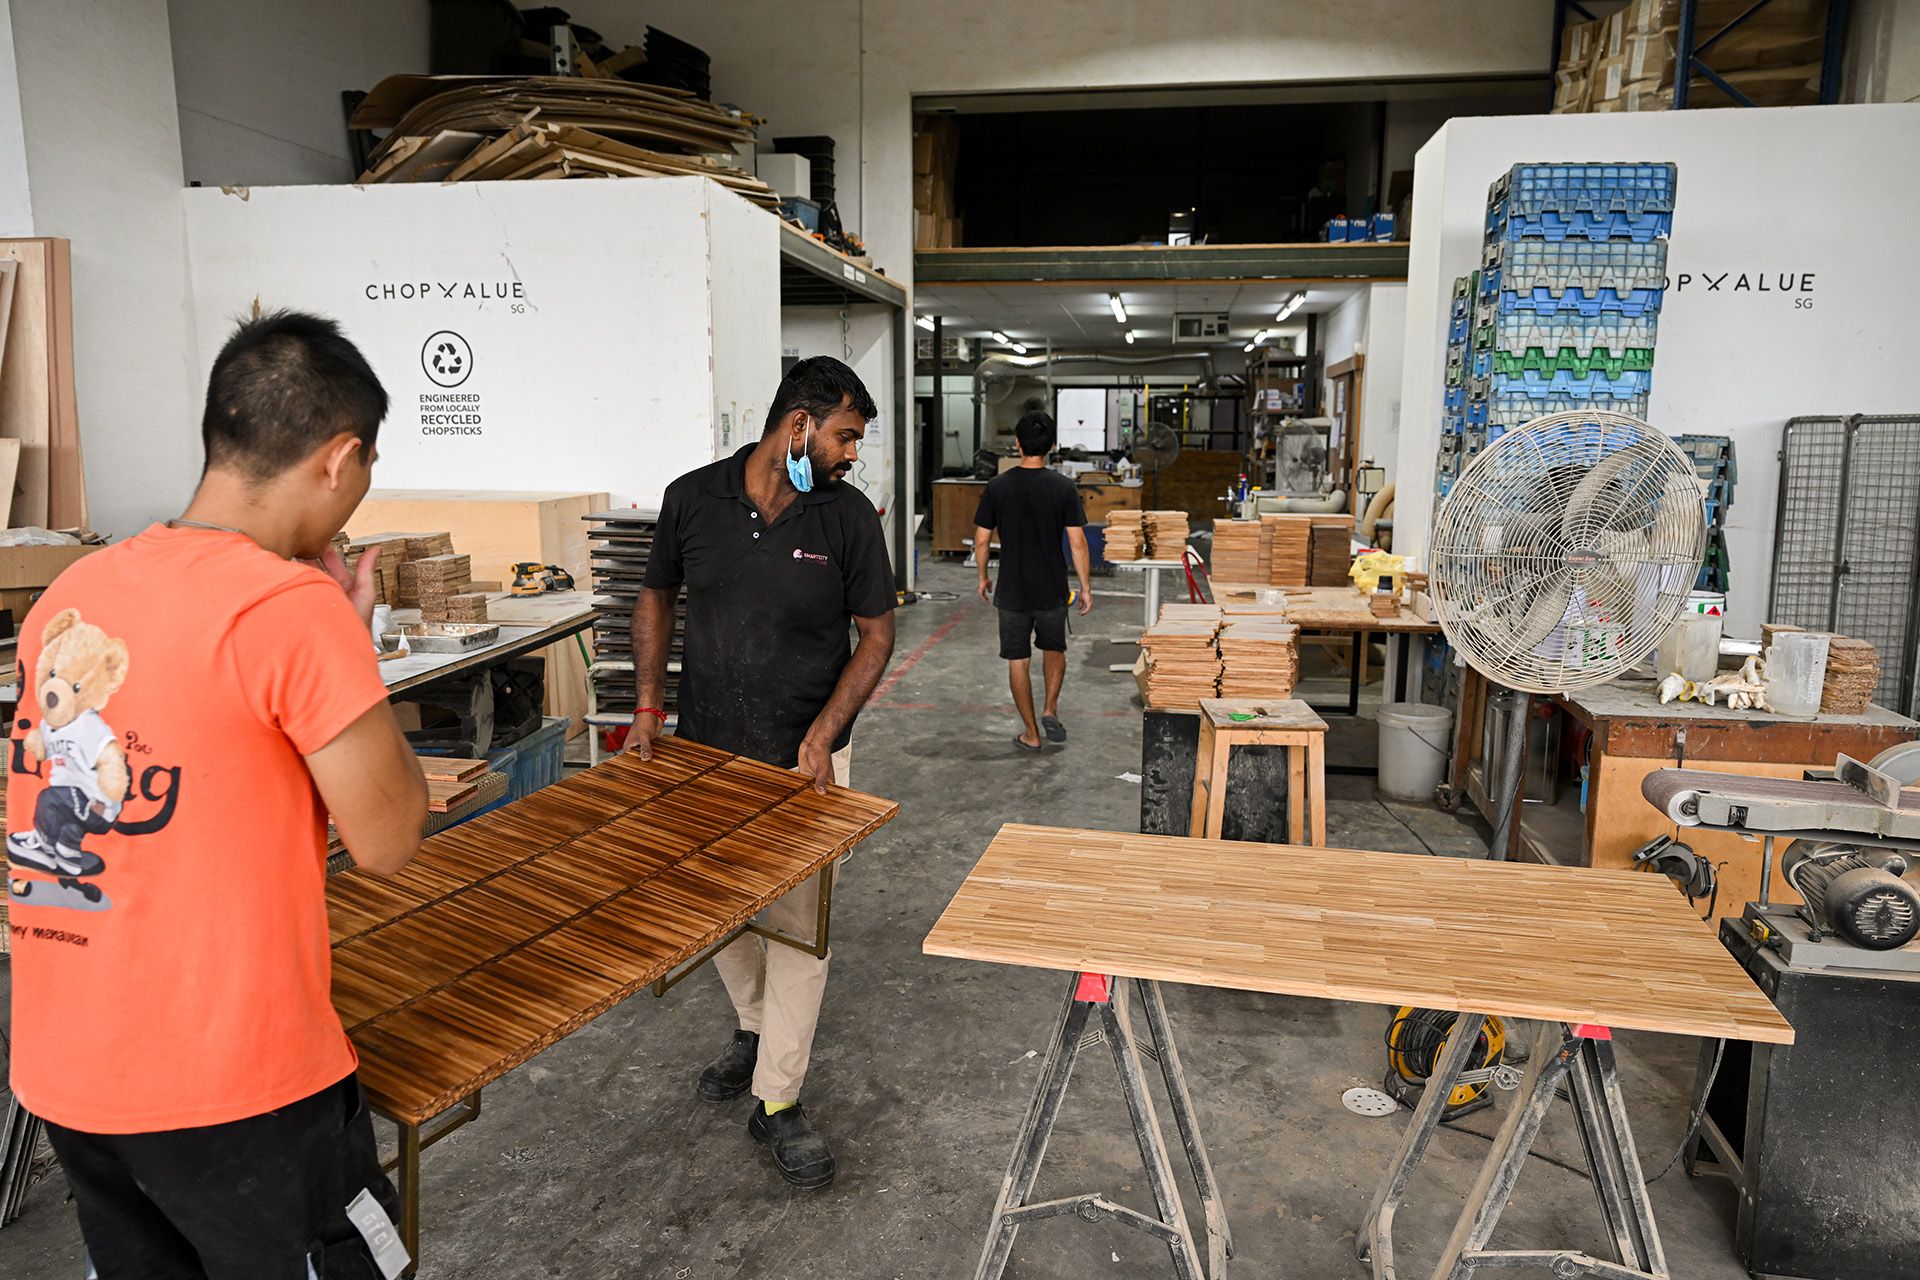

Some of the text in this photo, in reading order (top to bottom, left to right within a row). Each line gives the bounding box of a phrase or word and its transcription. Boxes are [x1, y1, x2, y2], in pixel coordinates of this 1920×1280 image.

[510, 303, 525, 314] SG
[1794, 298, 1813, 309] SG
[419, 394, 480, 403] ENGINEERED
[420, 404, 480, 412] FROM LOCALLY
[421, 414, 481, 425] RECYCLED
[422, 426, 482, 435] CHOPSTICKS
